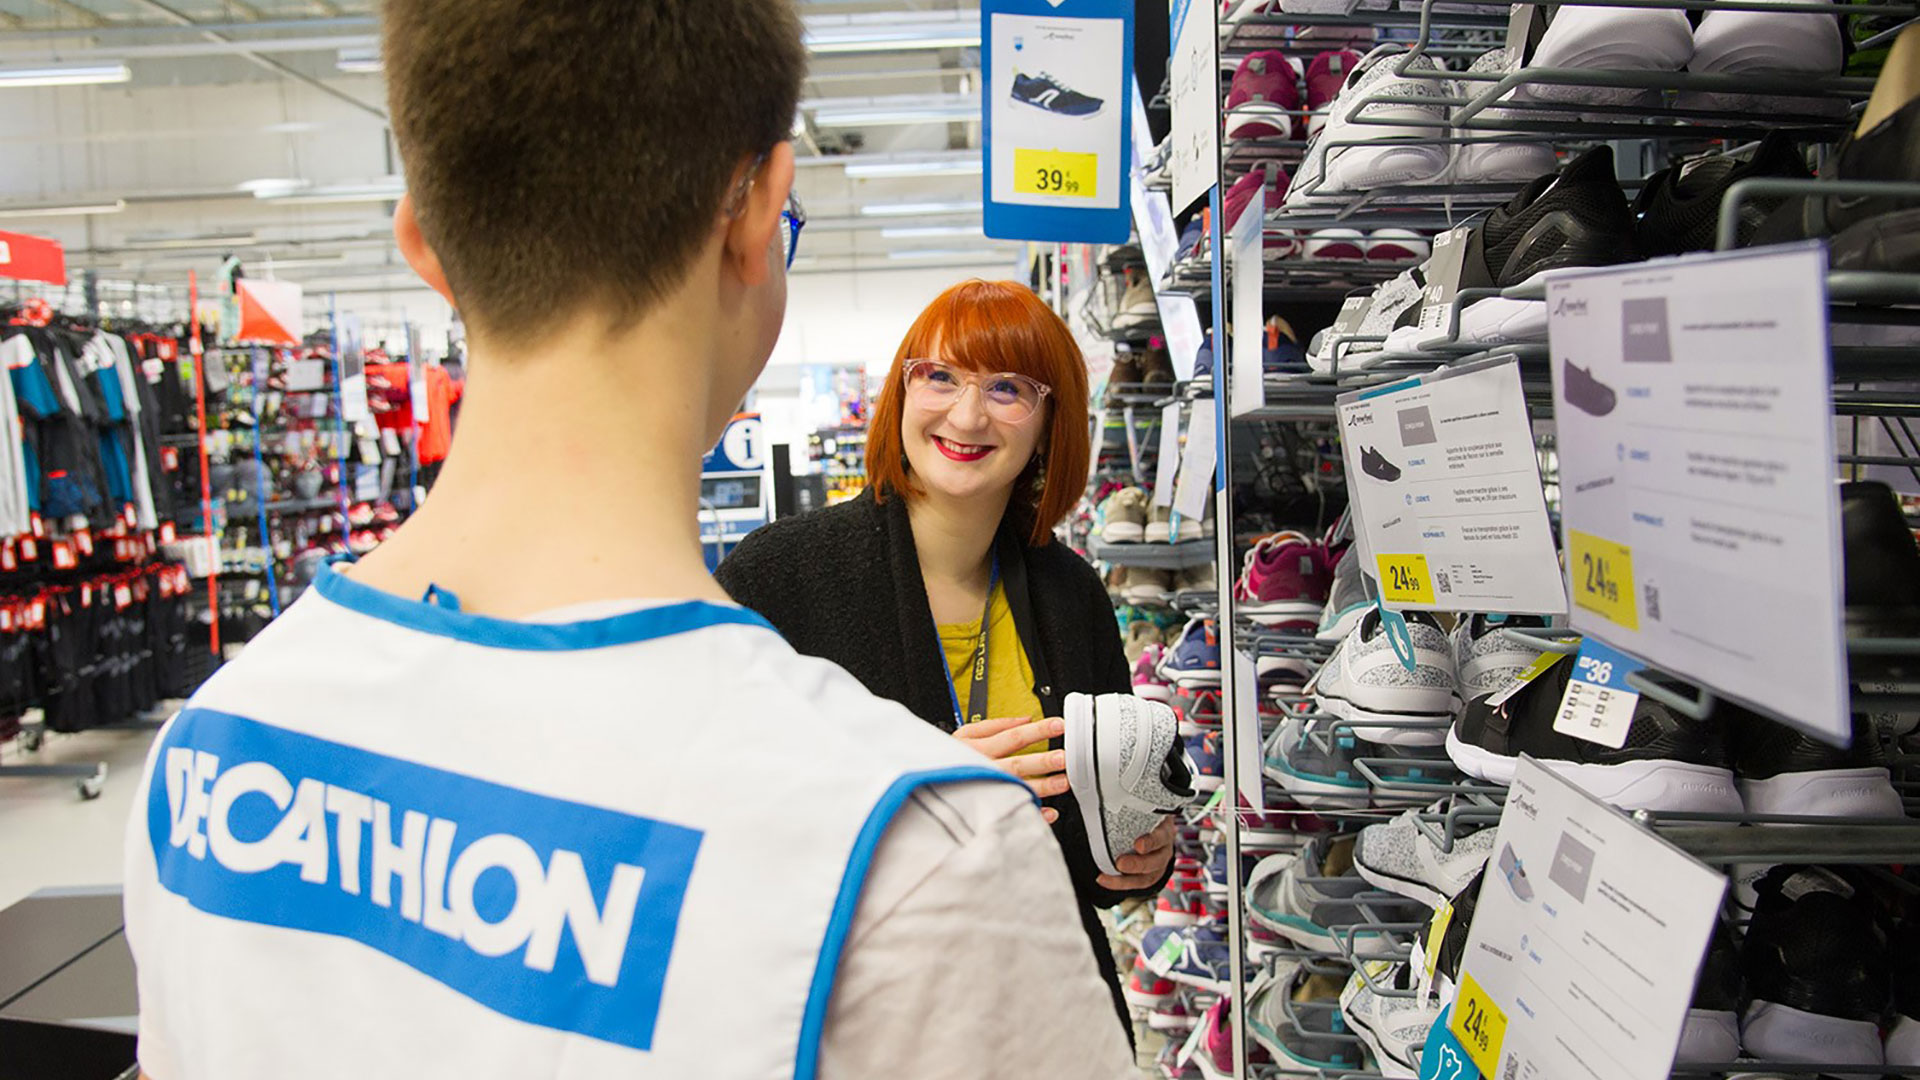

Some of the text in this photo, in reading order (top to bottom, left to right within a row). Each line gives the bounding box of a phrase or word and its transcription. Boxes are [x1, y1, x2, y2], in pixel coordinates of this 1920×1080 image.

[1036, 168, 1062, 191] 39
[1065, 181, 1080, 193] 99
[1429, 285, 1443, 303] 40
[1390, 565, 1410, 590] 24
[1409, 577, 1420, 591] 99
[1583, 553, 1607, 598] 24
[1586, 659, 1613, 684] 36
[165, 746, 645, 988] DECATHLON
[1463, 998, 1483, 1041] 24
